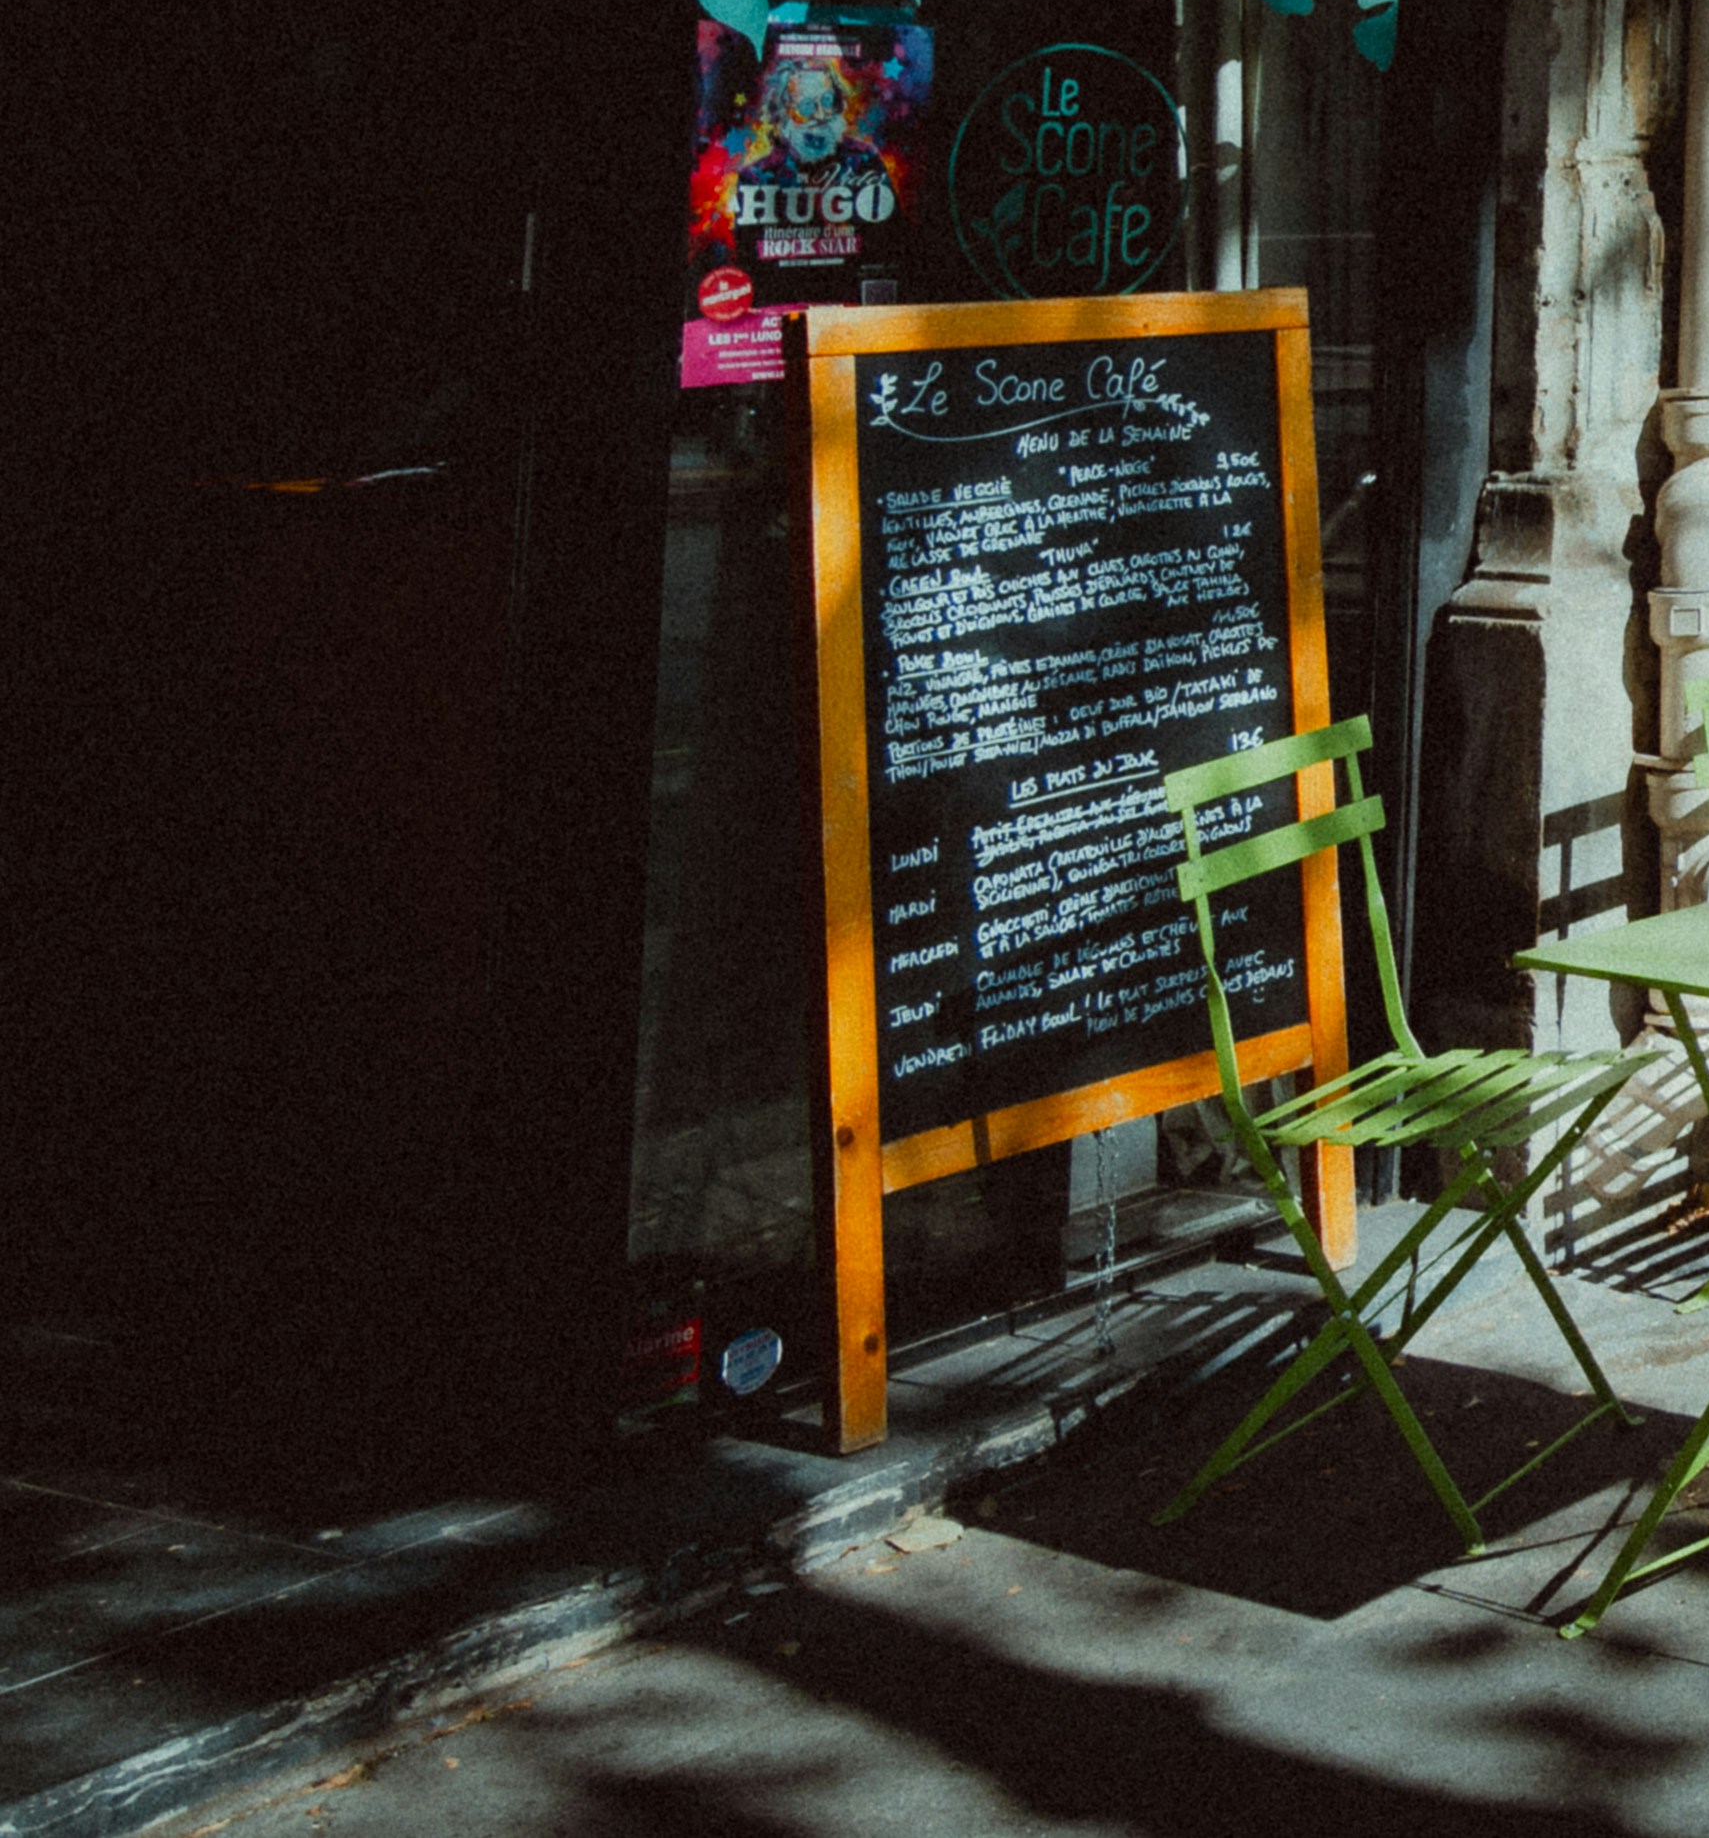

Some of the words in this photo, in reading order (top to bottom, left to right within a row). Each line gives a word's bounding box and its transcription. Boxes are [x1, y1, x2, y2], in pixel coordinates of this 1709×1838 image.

[1042, 66, 1080, 117] Le
[1000, 92, 1156, 177] Scone
[737, 183, 895, 226] HUGO
[762, 237, 816, 258] ROCK
[901, 361, 949, 416] Le
[976, 359, 1066, 406] Scone
[1087, 355, 1167, 420] Café
[1017, 433, 1060, 458] MENU
[1069, 429, 1090, 448] DE
[1099, 427, 1115, 444] LA
[886, 488, 943, 510] SALADE
[983, 519, 1019, 540] GREC
[1212, 490, 1233, 506] LA
[958, 542, 980, 558] DE
[896, 653, 936, 675] POKE
[1230, 726, 1265, 752] 13€
[1011, 776, 1039, 801] LES
[1045, 764, 1087, 791] PLATS
[1093, 760, 1113, 779] DU
[1115, 748, 1160, 773] JOUR
[972, 860, 1045, 897] CAPONATA
[1245, 794, 1264, 813] LA
[975, 959, 1045, 993] CRUMBLE
[1052, 950, 1071, 970] DE
[1220, 905, 1250, 928] AUX
[1014, 932, 1031, 949] LA
[1118, 983, 1149, 1005] PLAT
[1225, 948, 1266, 974] AVEC
[1141, 988, 1195, 1024] BONNES
[1244, 958, 1295, 989] DEDANS
